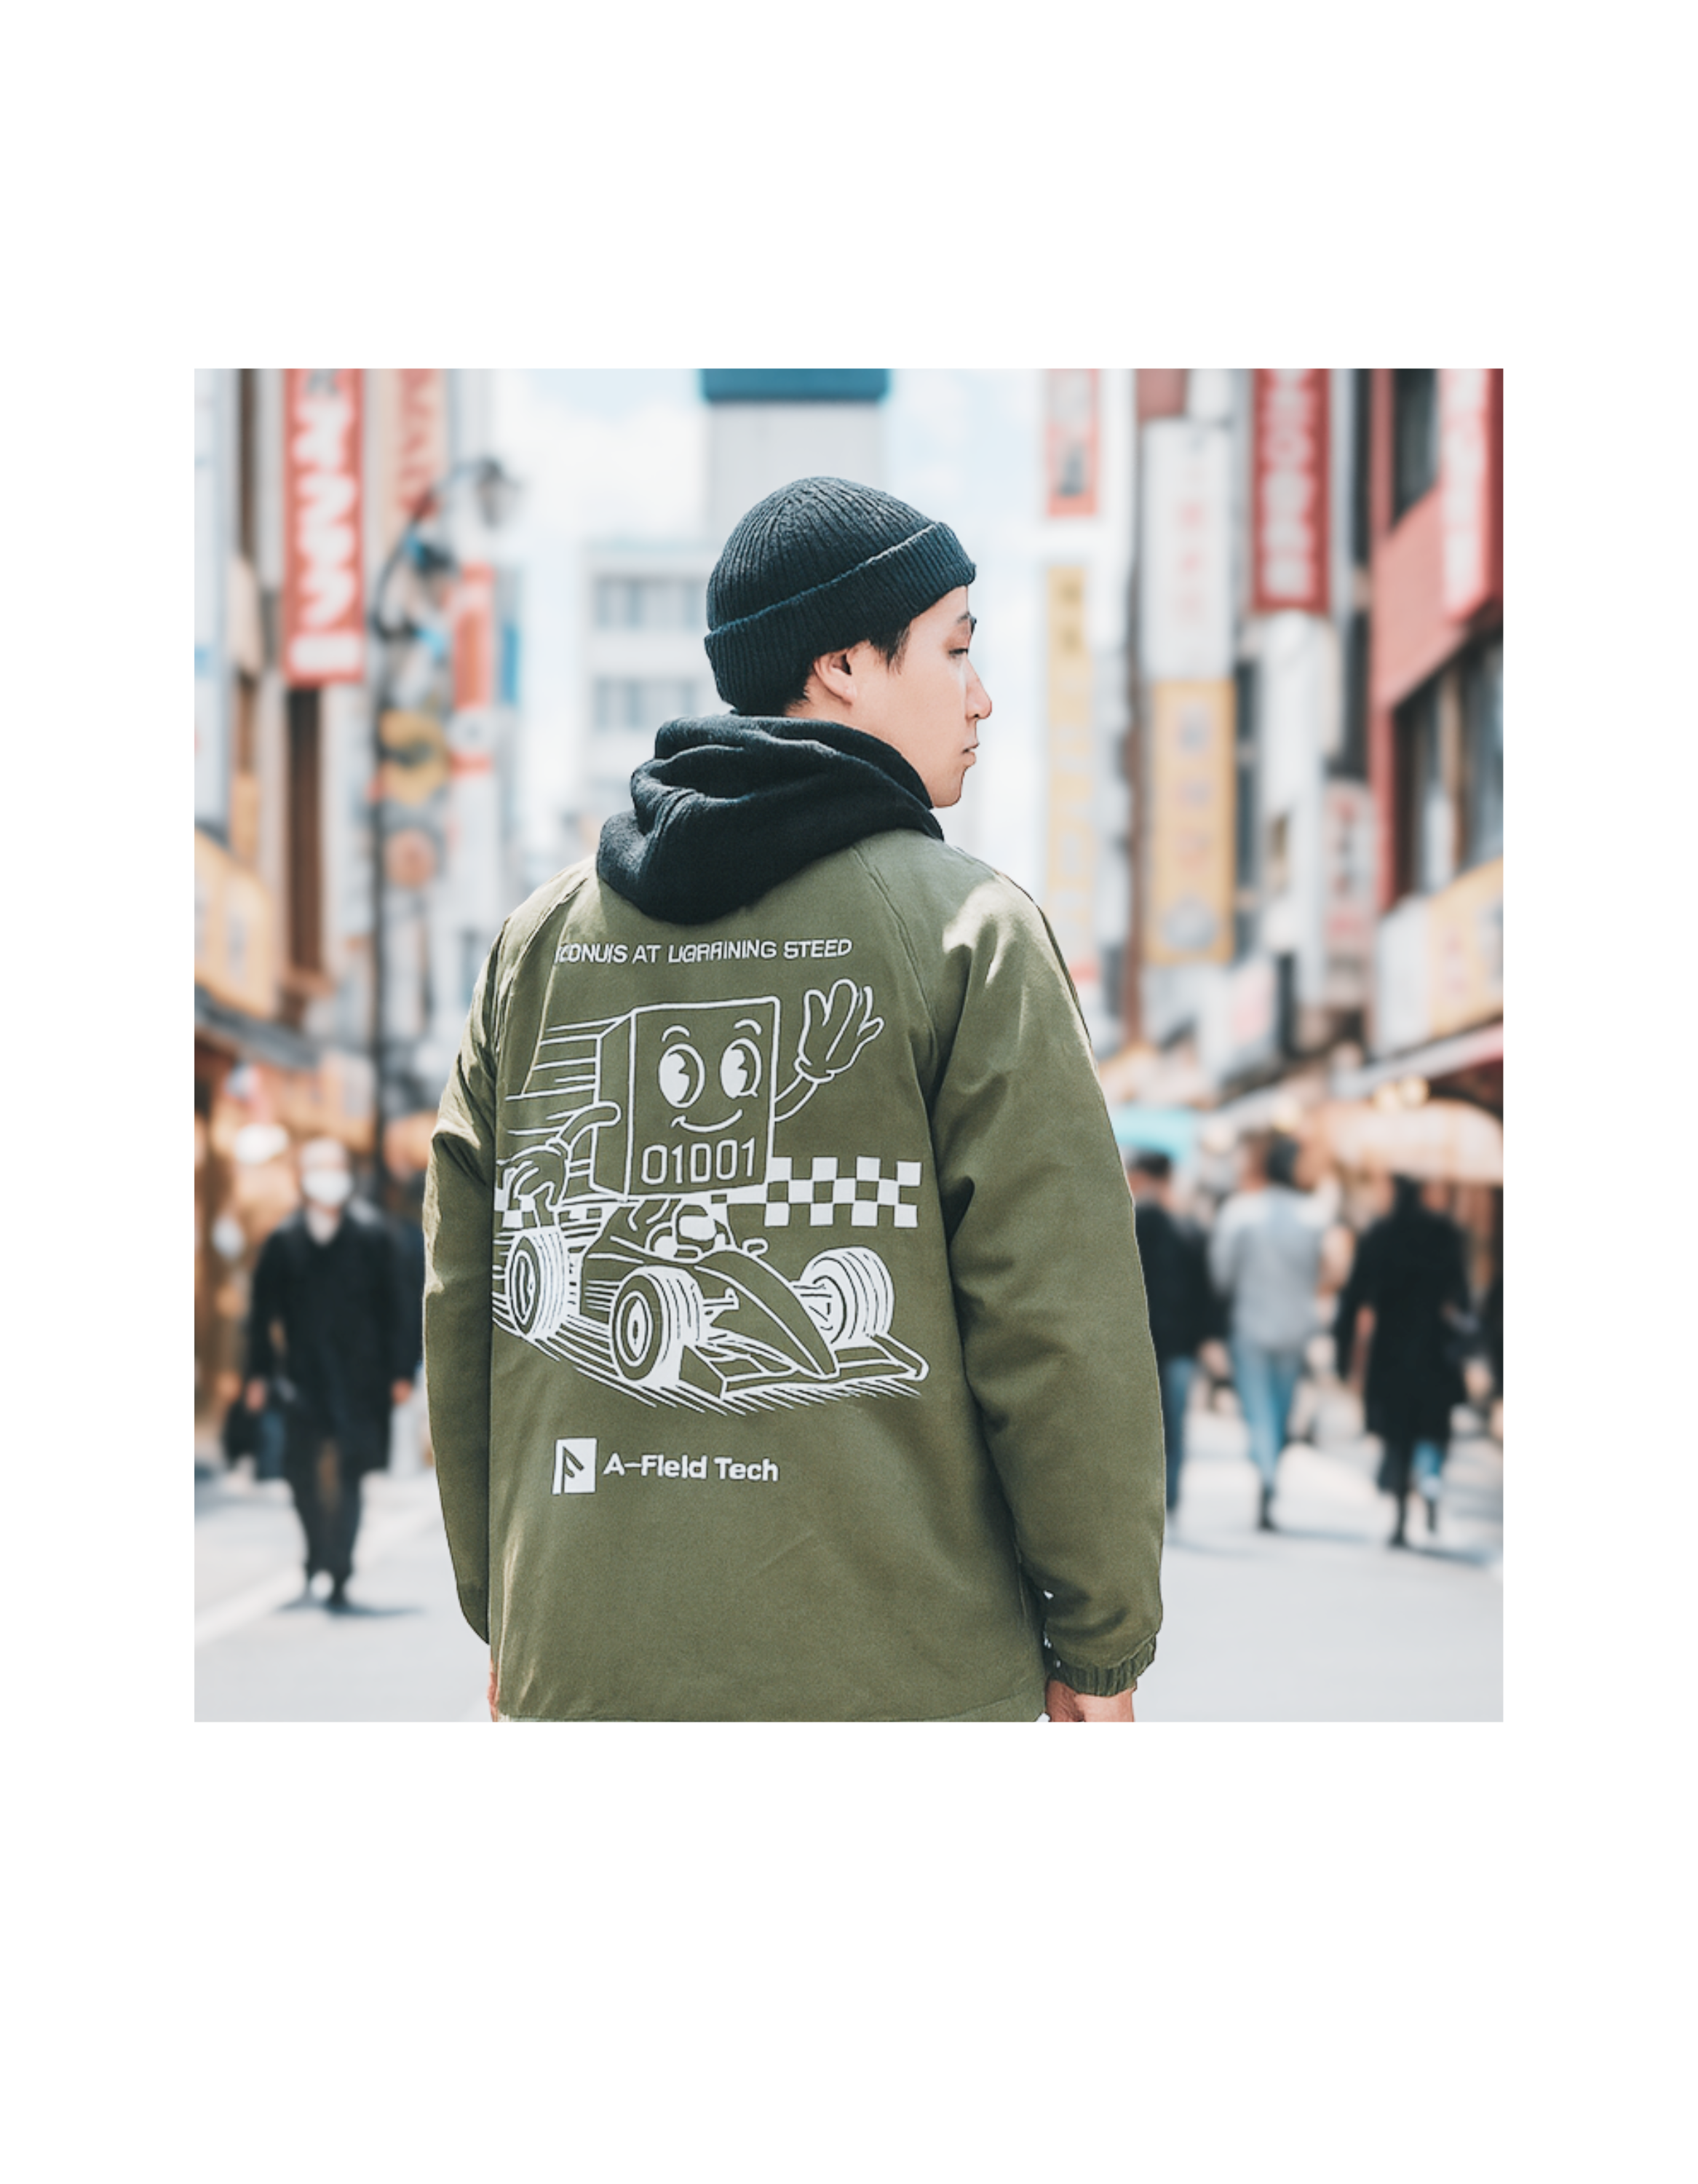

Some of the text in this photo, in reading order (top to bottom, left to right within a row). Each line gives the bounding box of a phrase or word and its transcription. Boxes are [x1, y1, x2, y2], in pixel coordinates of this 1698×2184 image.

[632, 944, 661, 964] AT
[783, 938, 853, 960] STEED
[640, 1137, 756, 1185] 01001
[713, 1457, 779, 1481] Tech
